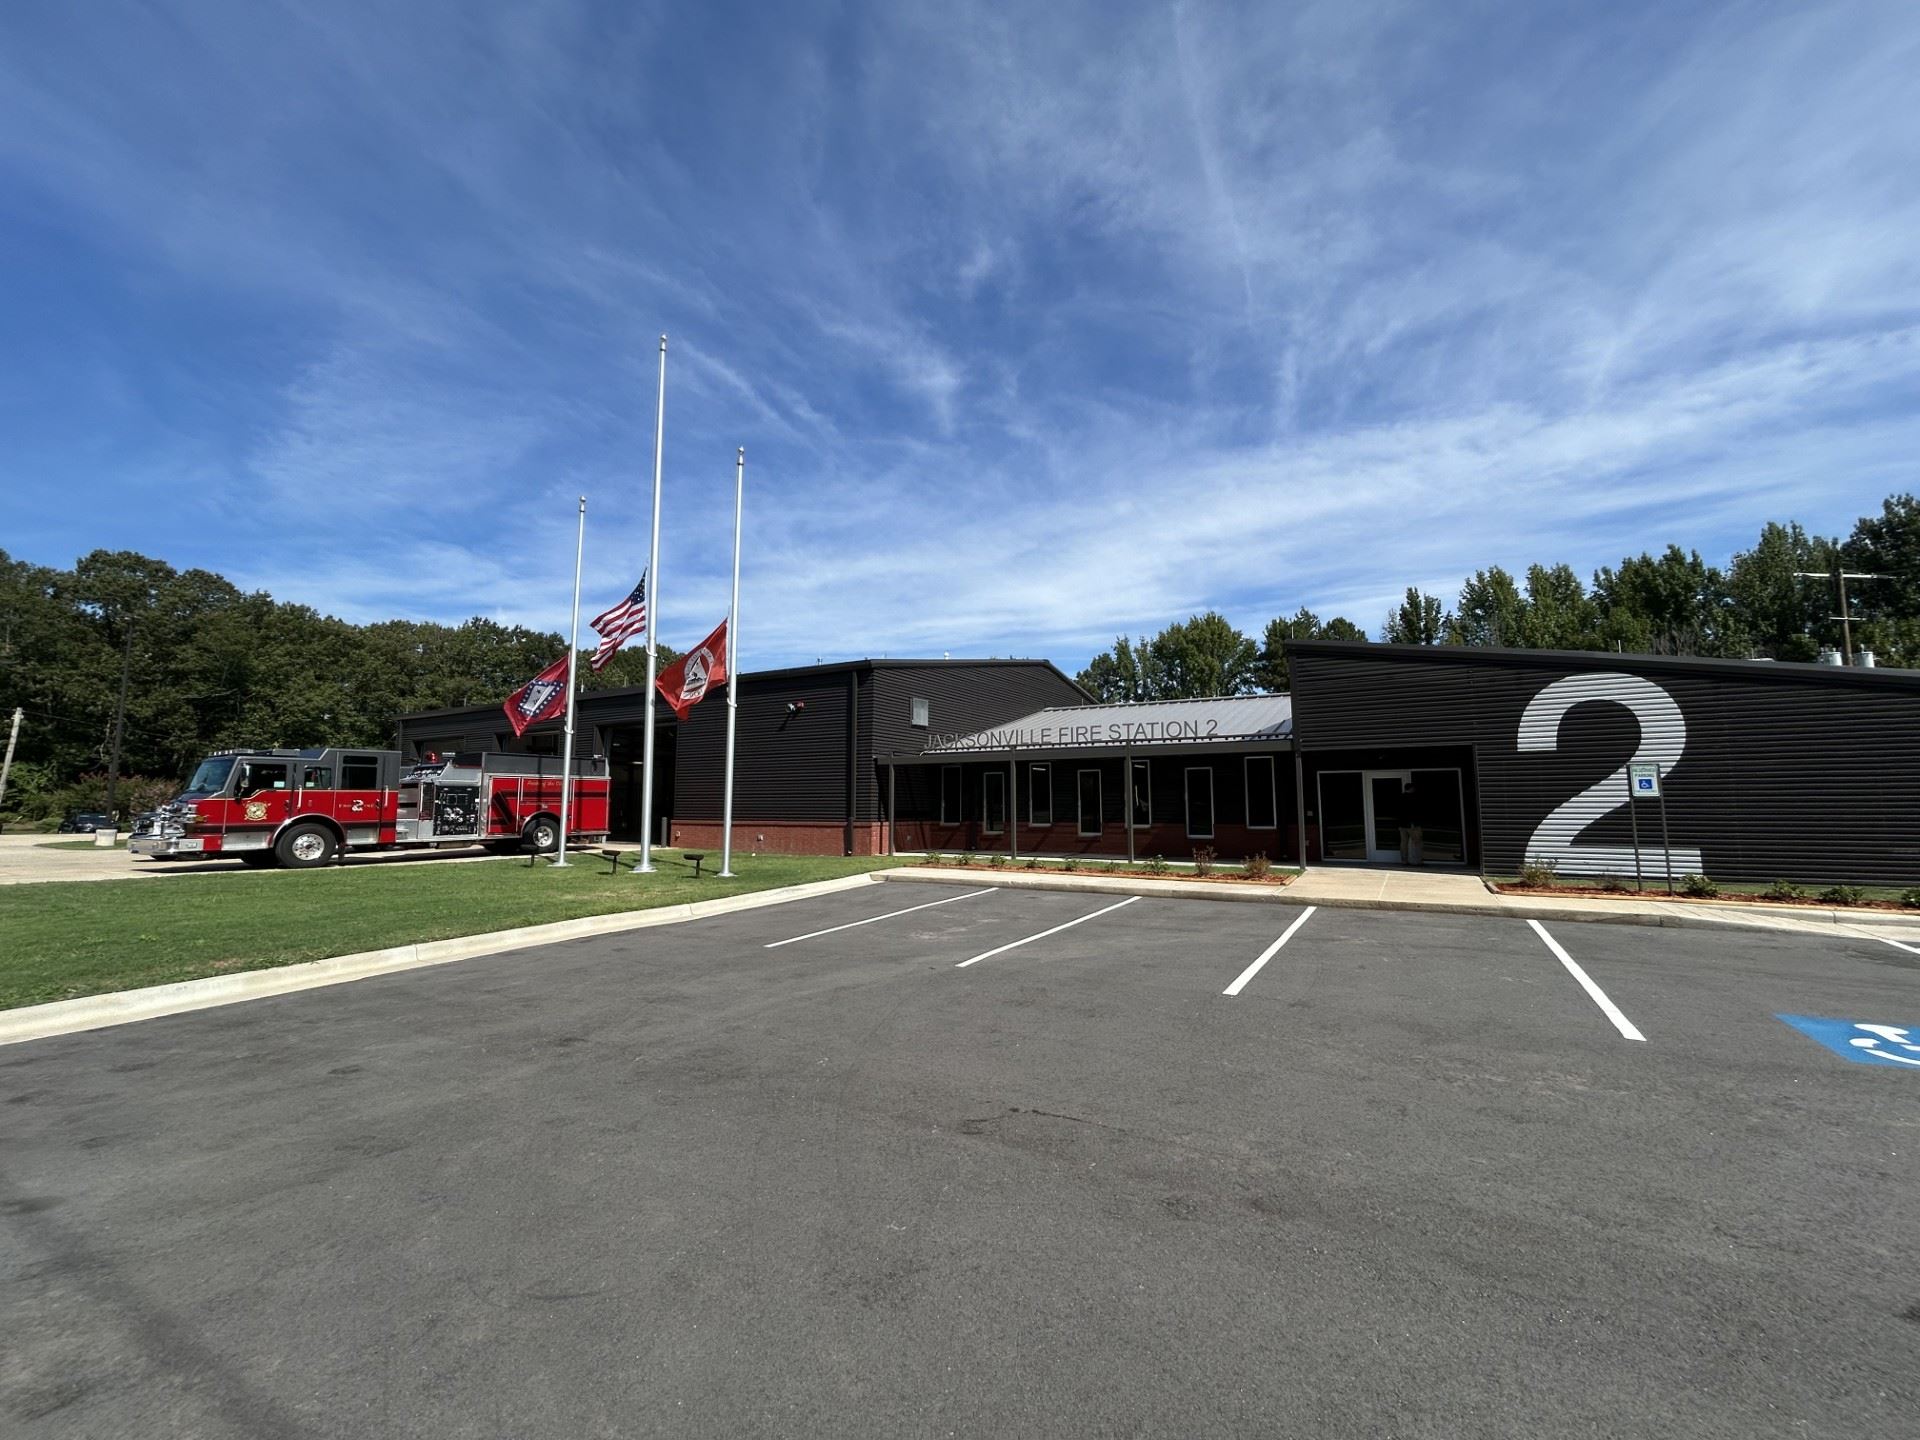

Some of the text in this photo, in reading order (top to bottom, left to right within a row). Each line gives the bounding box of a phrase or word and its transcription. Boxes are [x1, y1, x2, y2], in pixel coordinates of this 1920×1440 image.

[924, 719, 1219, 749] JACKSONVILLE FIRE STATION 2
[1517, 672, 1703, 877] 2
[351, 799, 364, 811] 2
